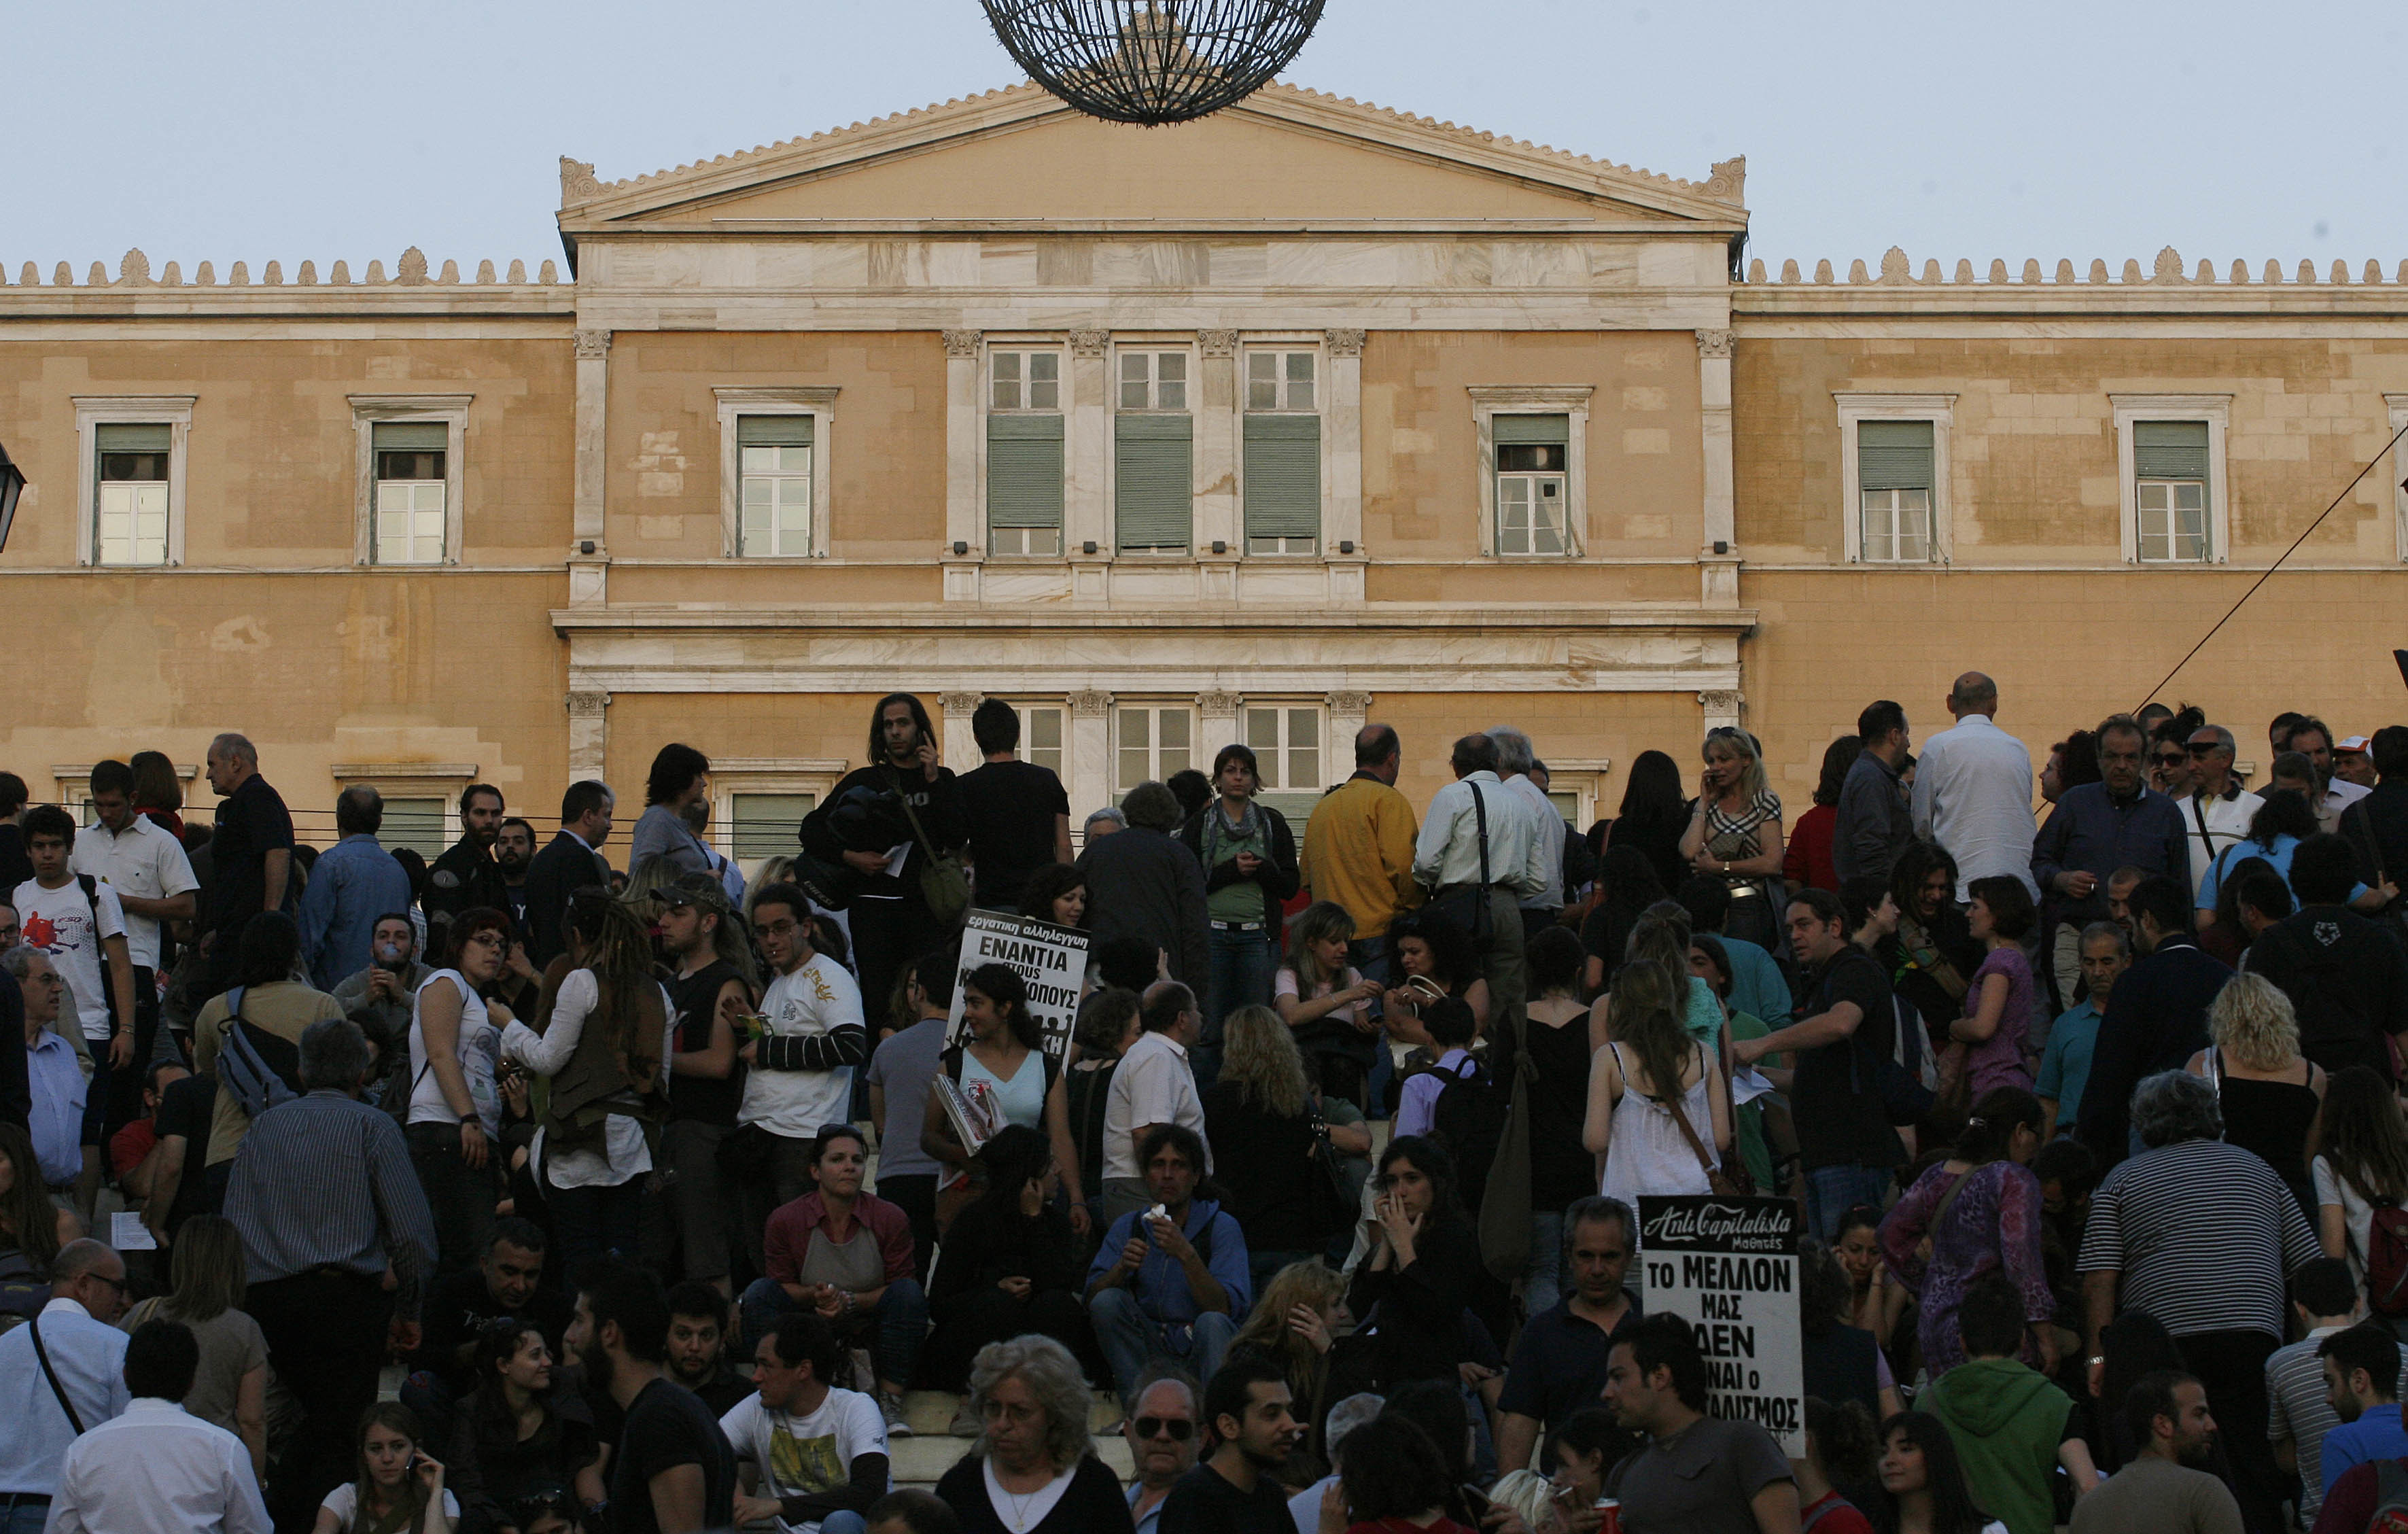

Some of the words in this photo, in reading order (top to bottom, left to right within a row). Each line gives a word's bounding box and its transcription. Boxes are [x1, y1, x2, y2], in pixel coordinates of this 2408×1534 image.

[979, 936, 1068, 972] ΕΝΑΝΤΙΑ
[1683, 1255, 1791, 1292] ΜΕΛΛΟΝ
[1701, 1293, 1741, 1320] ΜΑΣ
[1694, 1323, 1754, 1358] ΔΕΝ
